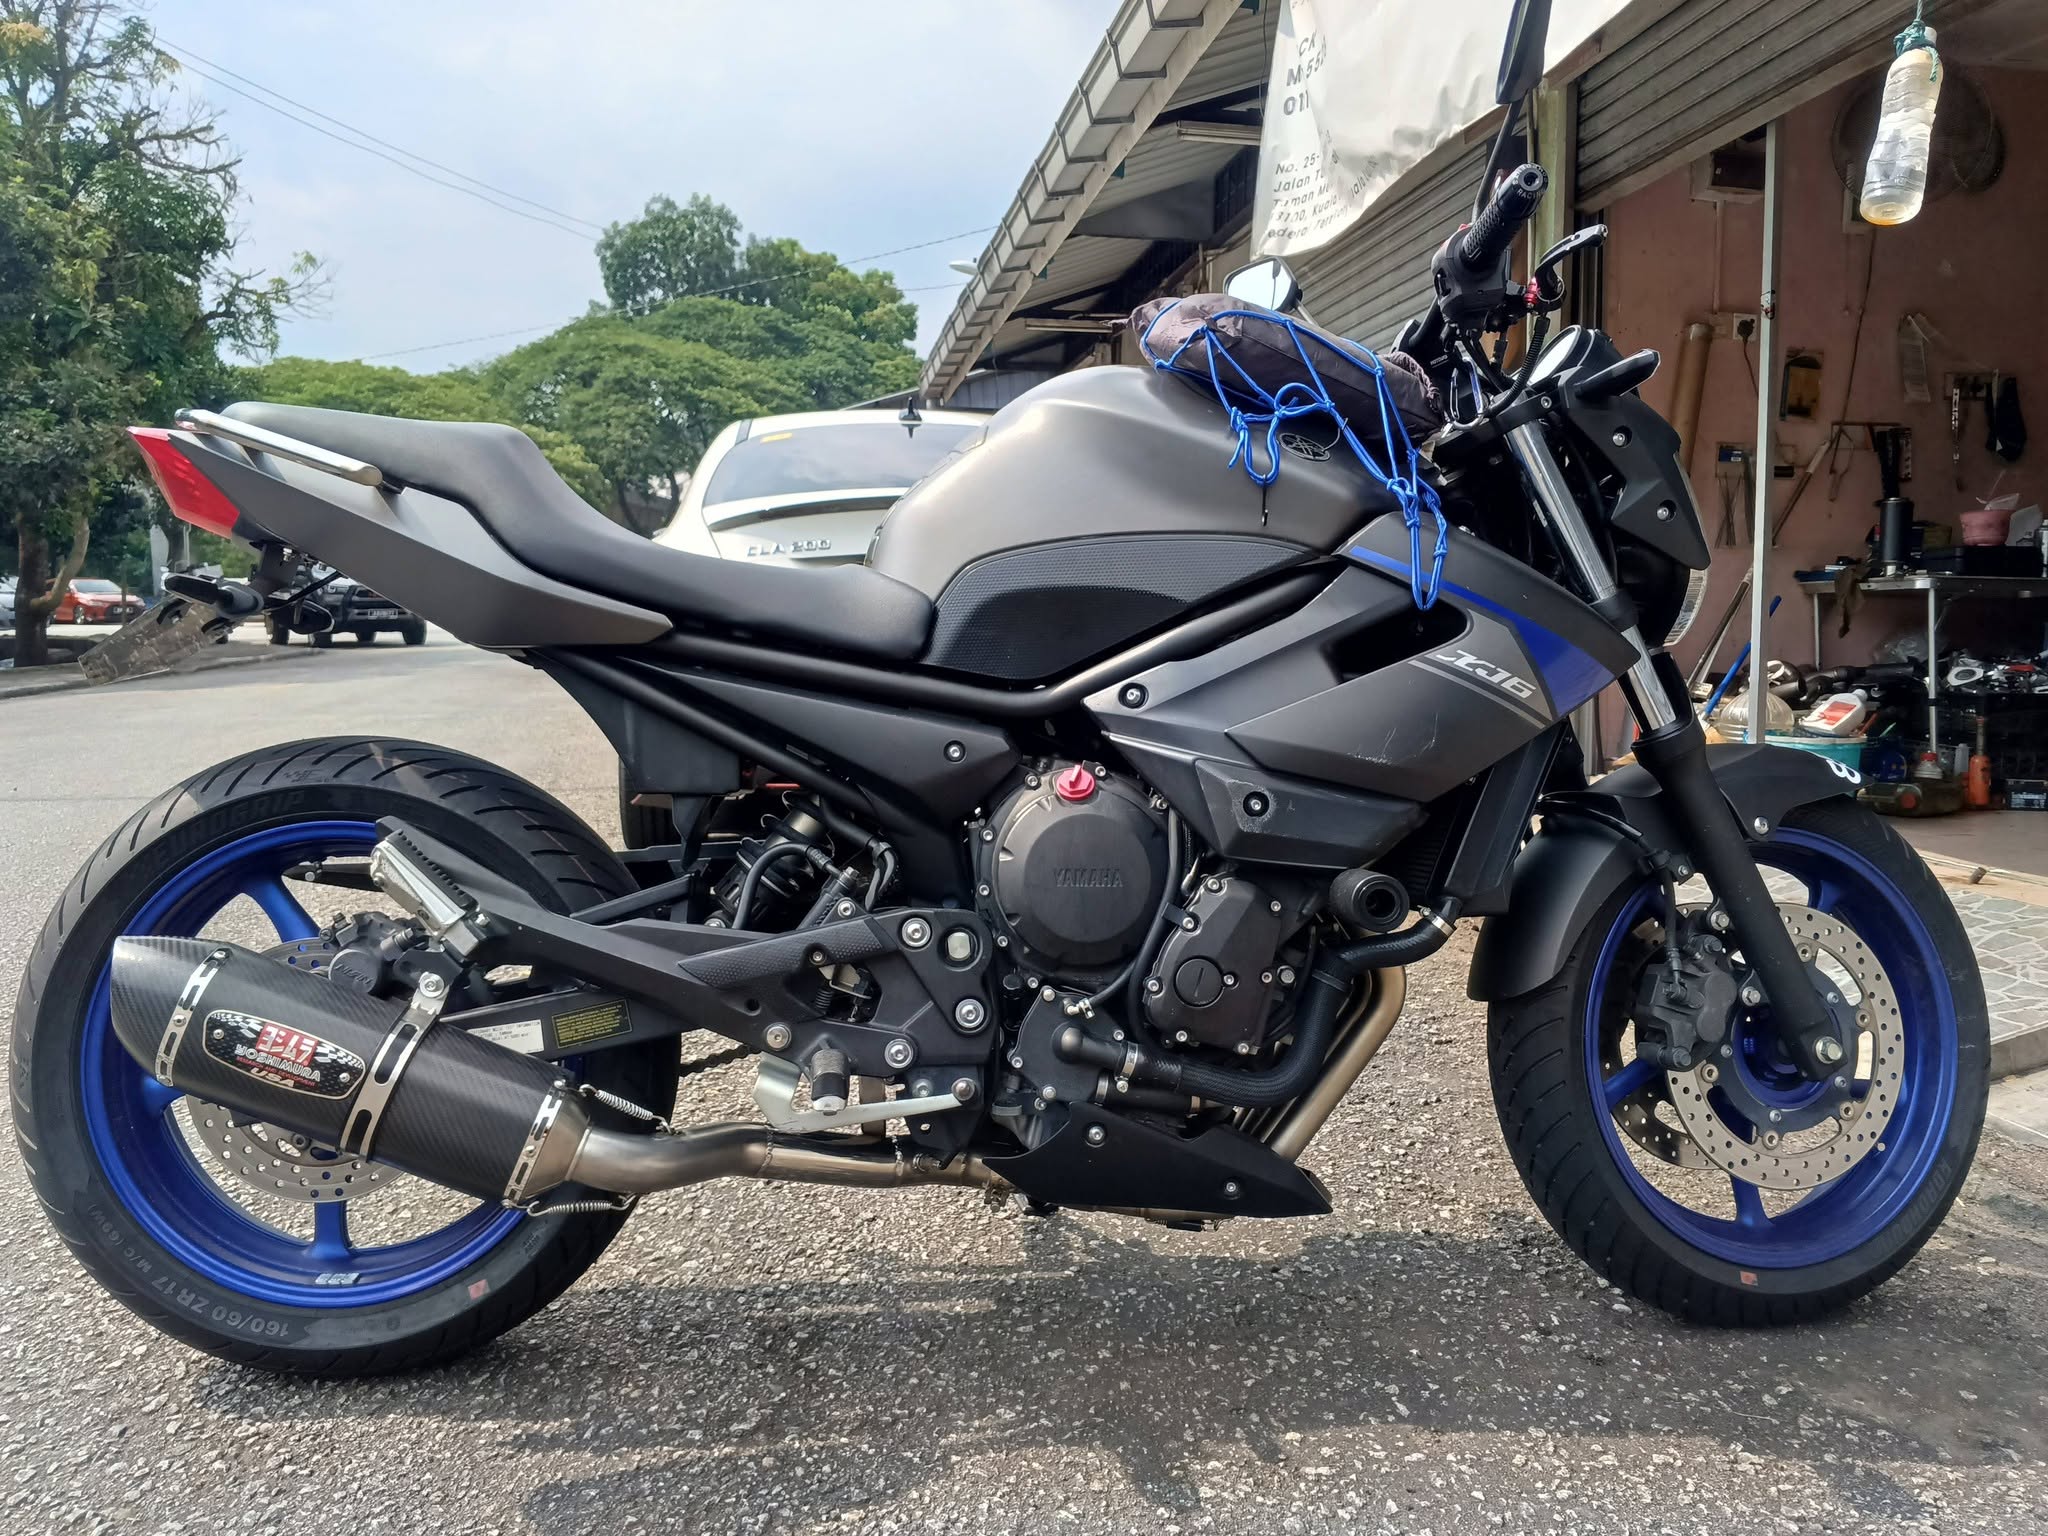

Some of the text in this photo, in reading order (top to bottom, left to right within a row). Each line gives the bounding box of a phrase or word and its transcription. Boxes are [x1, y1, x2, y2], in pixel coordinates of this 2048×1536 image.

[1275, 163, 1298, 175] No.
[1273, 175, 1311, 192] Jalan
[747, 539, 832, 557] CLA 200
[1053, 868, 1124, 888] YAMAHA
[258, 1025, 316, 1063] ヨシムラ
[234, 1044, 321, 1082] YOSHIMURA
[250, 1067, 295, 1088] USA
[123, 1247, 153, 1273] M/C
[151, 1276, 177, 1295] 17
[176, 1288, 210, 1314] ZR
[211, 1305, 289, 1338] 160/60
